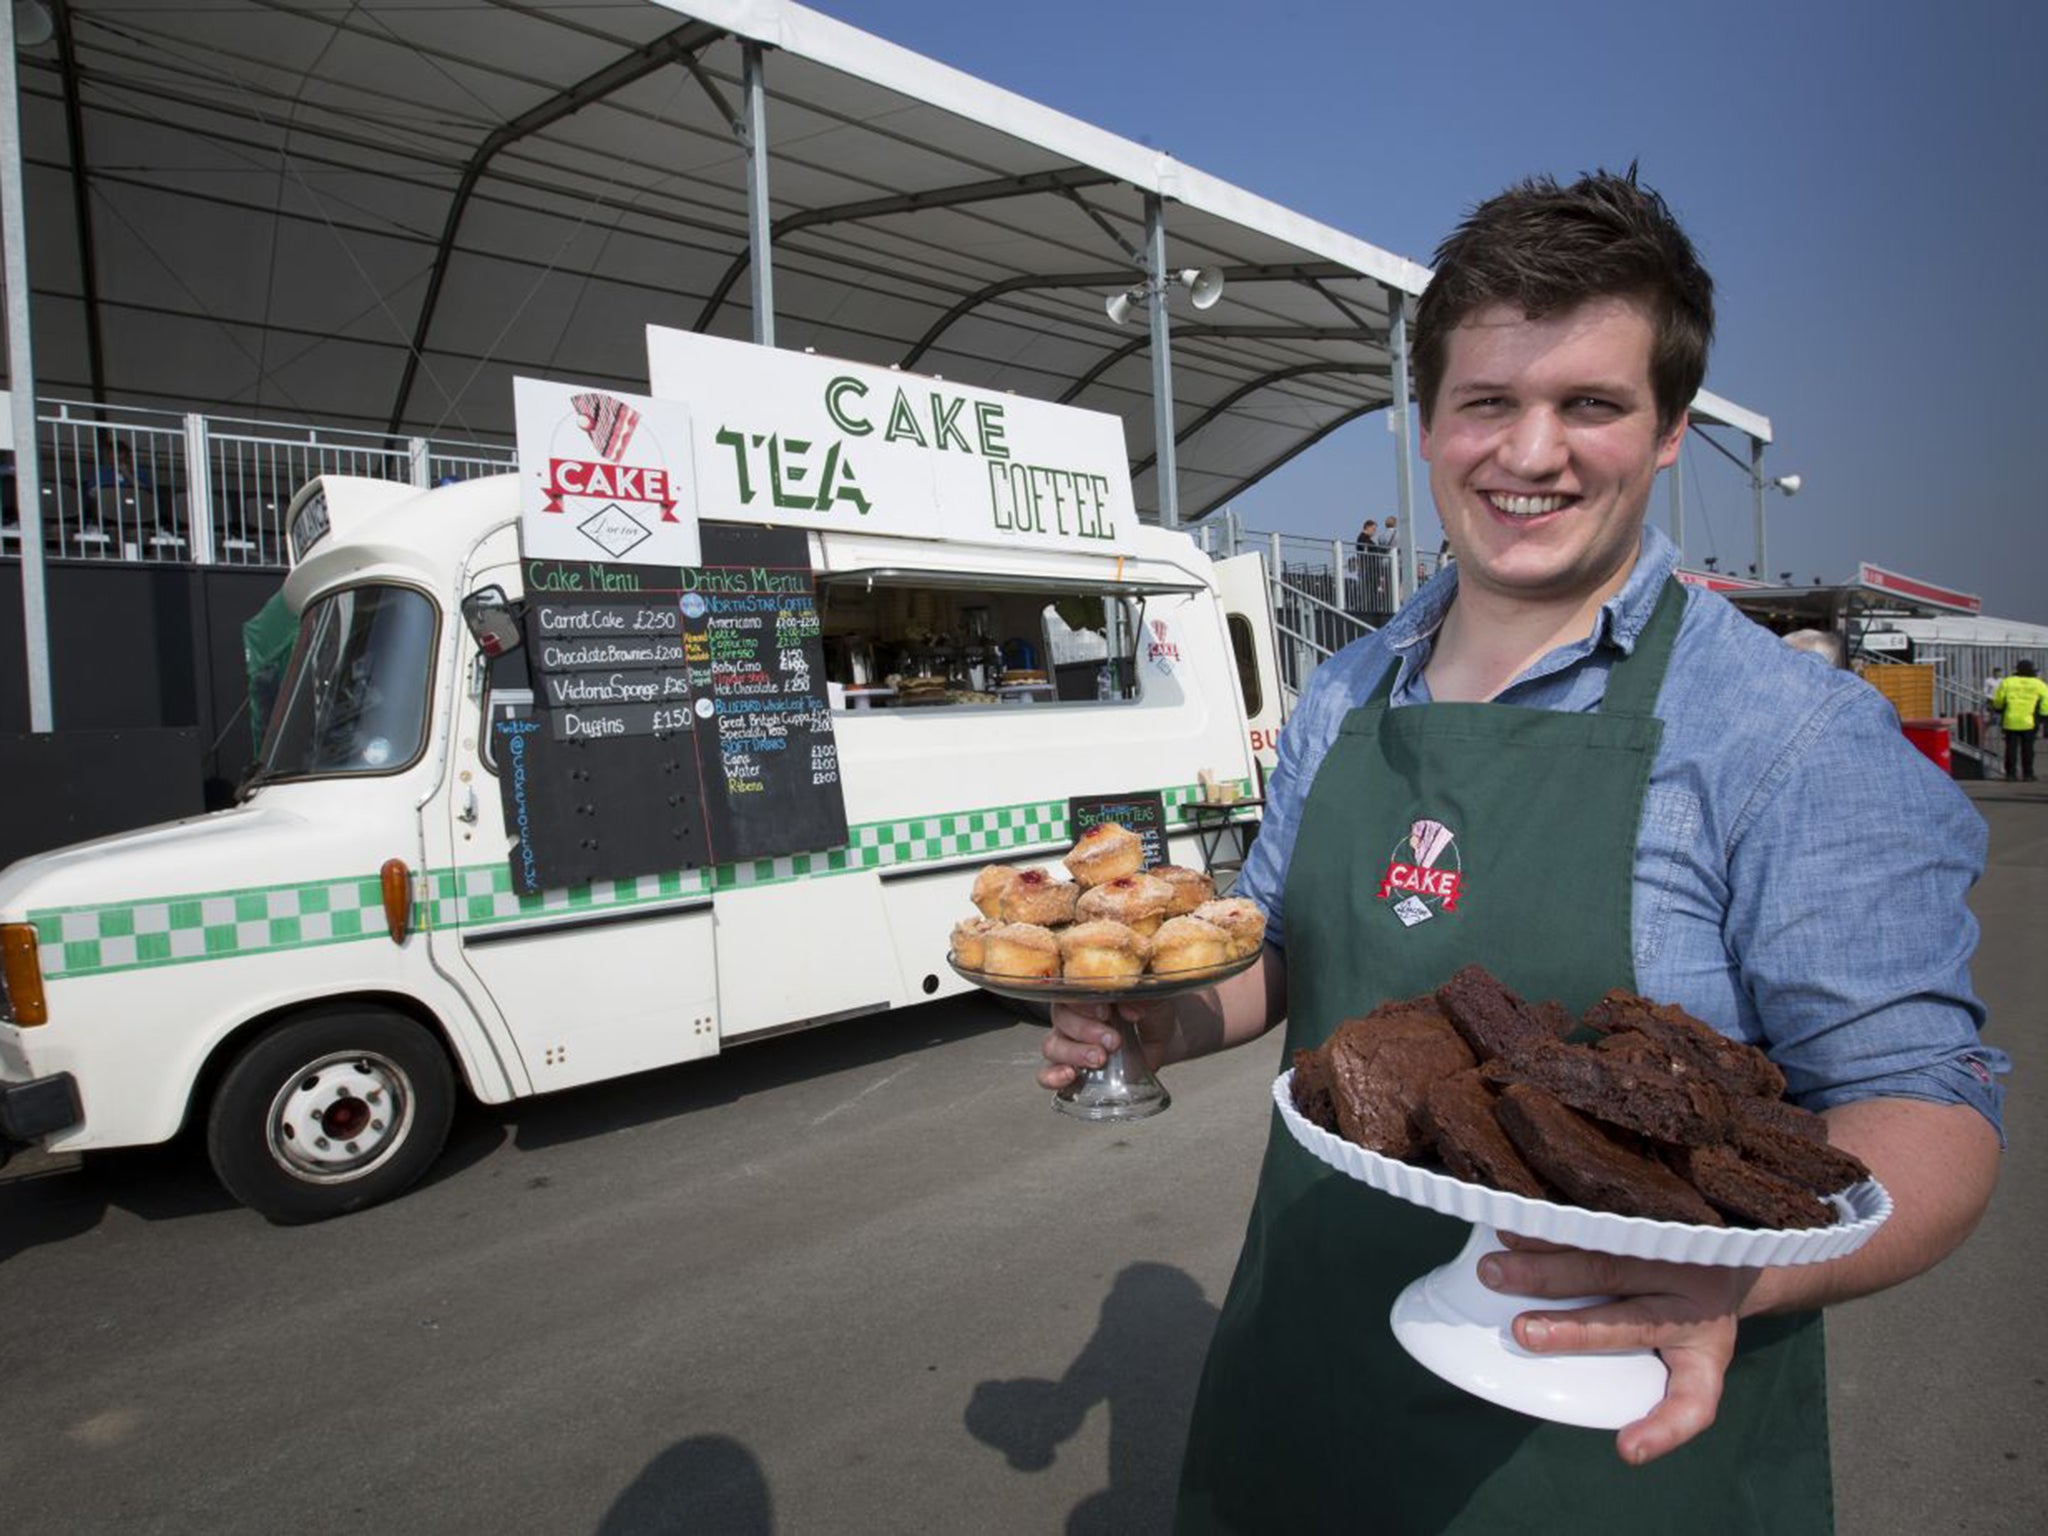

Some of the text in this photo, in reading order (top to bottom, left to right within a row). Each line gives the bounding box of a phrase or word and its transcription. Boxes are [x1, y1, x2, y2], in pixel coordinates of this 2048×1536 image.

[825, 376, 1010, 459] CAKE
[556, 461, 664, 500] CAKE
[716, 425, 873, 515] TEA
[989, 460, 1115, 540] COFFEE
[529, 561, 639, 592] Cake Menu
[681, 567, 804, 592] Drinks Menu
[541, 608, 590, 629] Carrot
[592, 610, 625, 629] Cake
[544, 647, 607, 667] Chocolate
[554, 679, 611, 700] Victoria
[610, 673, 659, 701] Sponge
[1391, 866, 1456, 895] CAKE
